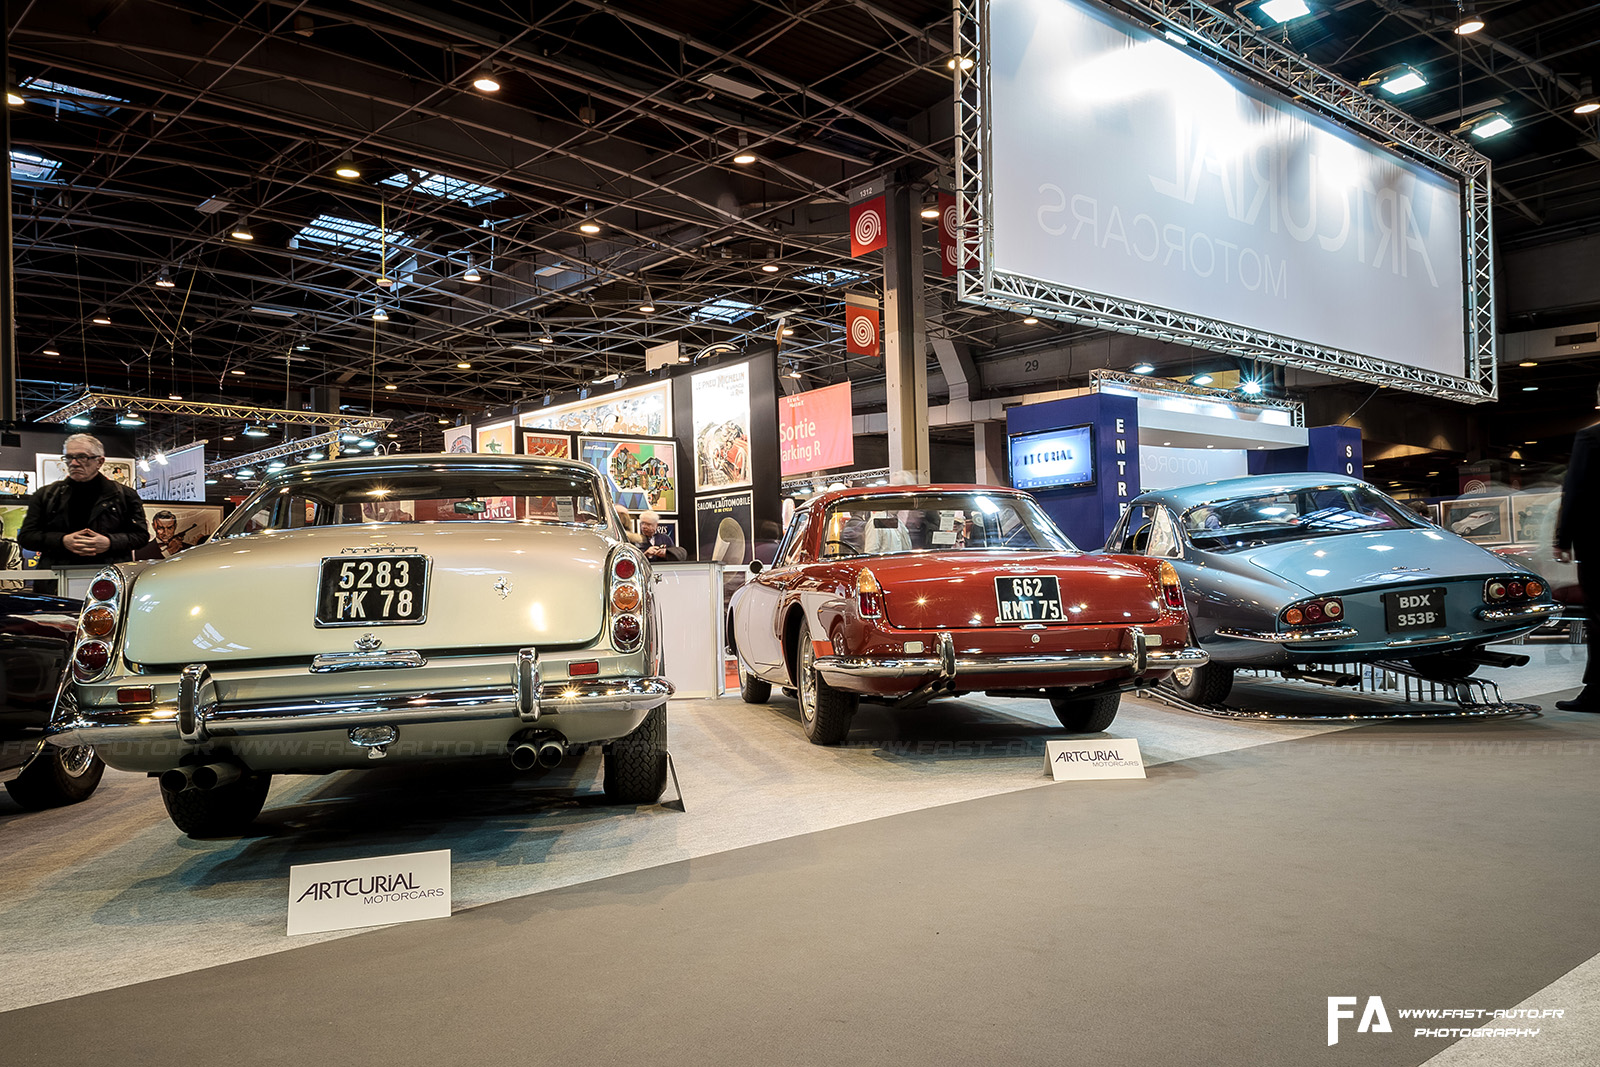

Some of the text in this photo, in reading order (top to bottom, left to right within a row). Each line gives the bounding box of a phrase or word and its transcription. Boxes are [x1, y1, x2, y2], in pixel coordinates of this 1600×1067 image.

[860, 187, 873, 198] 1312
[1025, 359, 1039, 373] 29
[780, 417, 816, 443] Sortie
[542, 438, 564, 446] FRANCE
[781, 440, 821, 462] arking R
[697, 501, 713, 511] SALON
[339, 560, 410, 589] 5283
[1012, 578, 1044, 597] 662
[334, 589, 413, 619] TK 78
[1399, 594, 1431, 609] BDX
[1001, 600, 1060, 620] RMT 75
[1397, 611, 1436, 627] 353B
[363, 888, 444, 904] MOTORCARS
